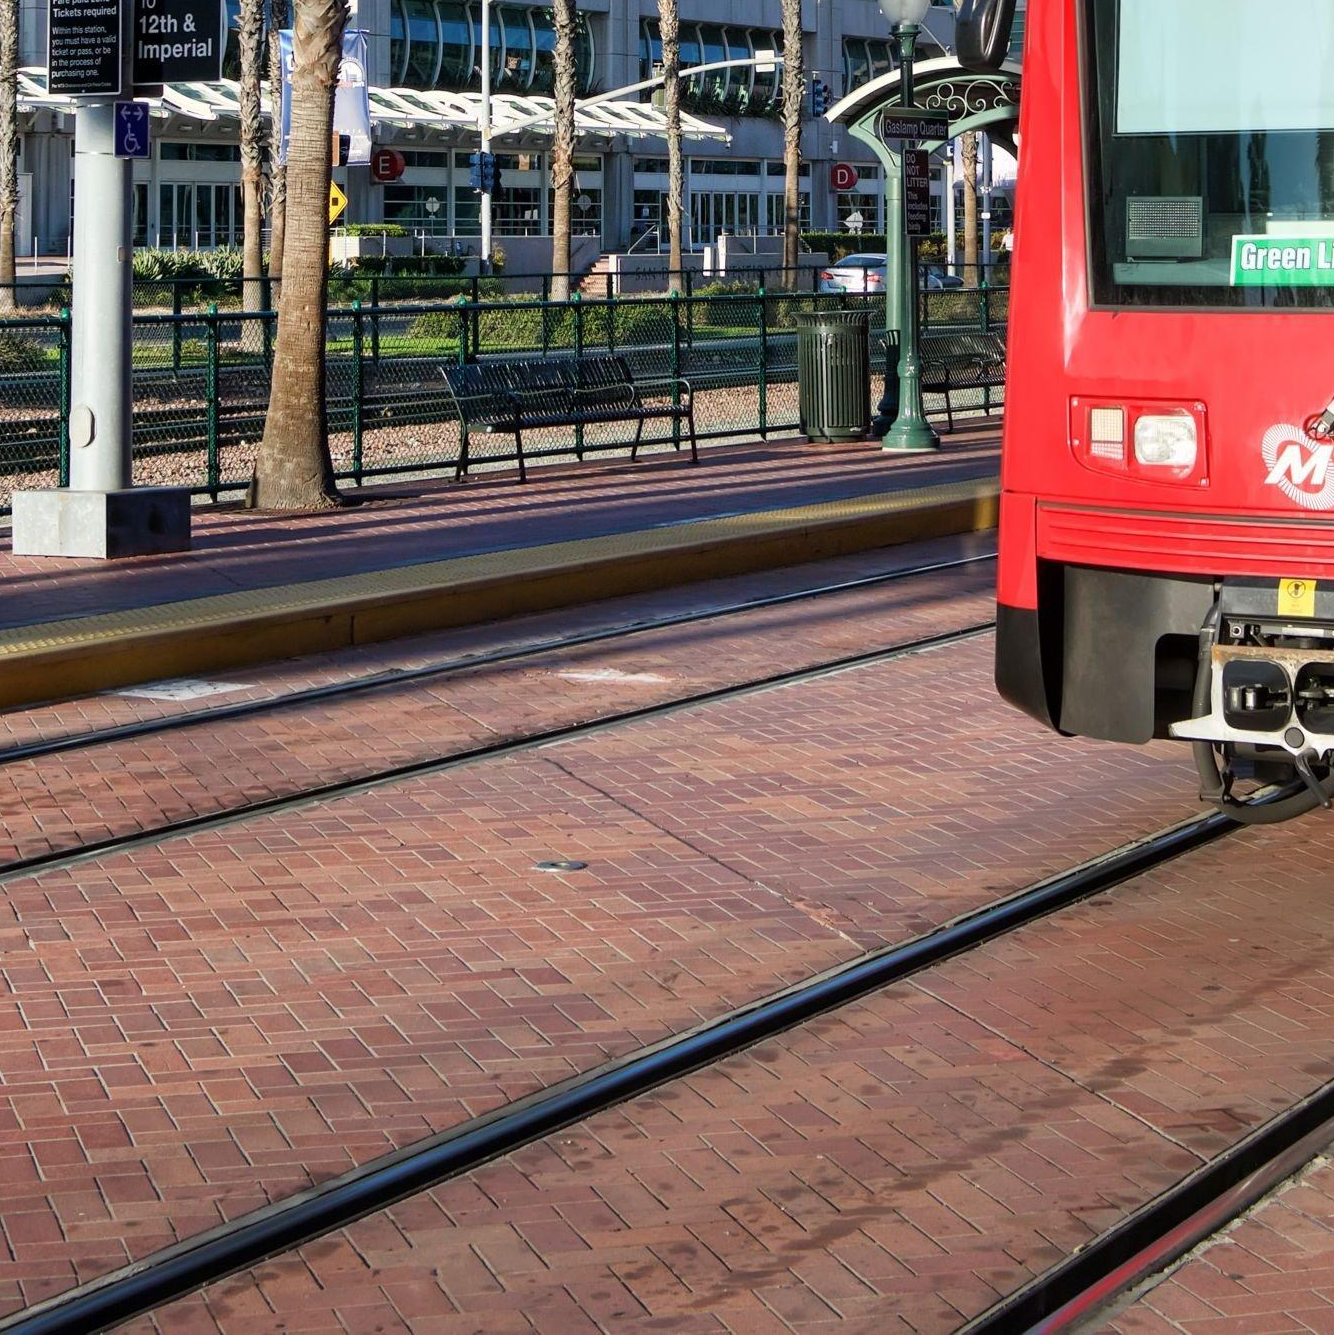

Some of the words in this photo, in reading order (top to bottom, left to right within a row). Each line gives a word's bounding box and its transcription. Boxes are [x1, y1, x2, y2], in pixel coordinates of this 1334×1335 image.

[53, 8, 82, 18] Tickets
[84, 6, 117, 18] required
[139, 14, 178, 34] 12th
[183, 13, 196, 32] &
[52, 26, 71, 35] Within
[72, 26, 83, 34] this
[85, 25, 107, 34] station,
[52, 39, 63, 47] you
[65, 37, 80, 45] must
[81, 36, 95, 44] have
[102, 35, 116, 43] valid
[52, 48, 69, 56] ticket
[77, 48, 94, 57] pass,
[102, 46, 111, 54] be
[138, 38, 212, 62] Imperial
[52, 59, 58, 67] in
[59, 58, 68, 67] the
[69, 59, 94, 67] process
[95, 57, 102, 65] of
[52, 69, 84, 79] purchasing
[85, 69, 99, 77] one.
[885, 119, 918, 137] Gaslamp
[920, 120, 946, 136] Quarter
[907, 153, 916, 164] DO
[379, 156, 390, 174] E
[907, 165, 919, 176] NOT
[837, 169, 848, 184] D
[907, 177, 928, 187] LITTER
[1240, 242, 1311, 271] Green
